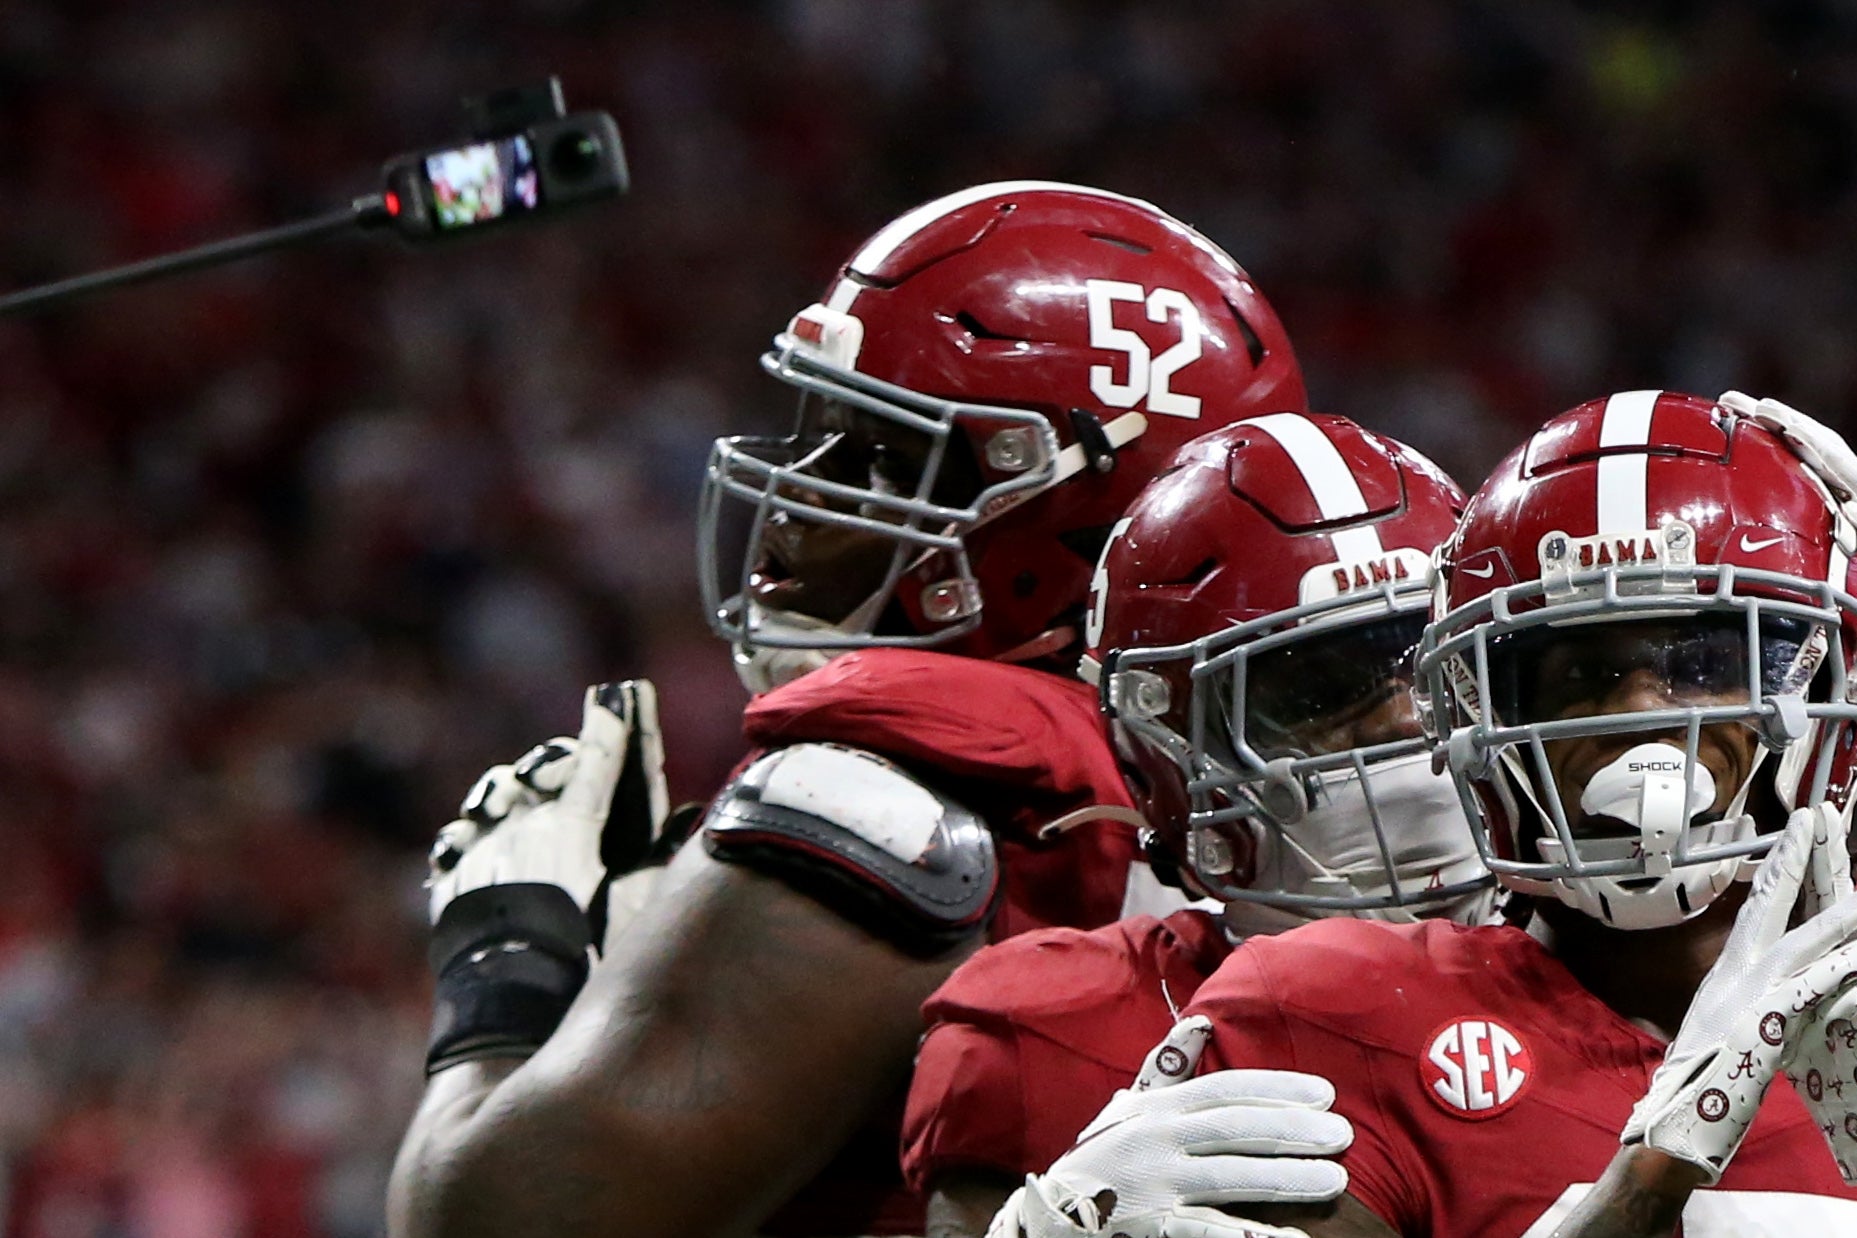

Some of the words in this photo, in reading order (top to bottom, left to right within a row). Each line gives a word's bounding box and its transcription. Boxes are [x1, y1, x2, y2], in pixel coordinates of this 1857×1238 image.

[1086, 279, 1202, 420] 52
[1579, 537, 1657, 567] BAMA
[1333, 556, 1409, 592] BAMA
[1628, 761, 1682, 772] SHOCK
[1427, 1020, 1528, 1111] SEC
